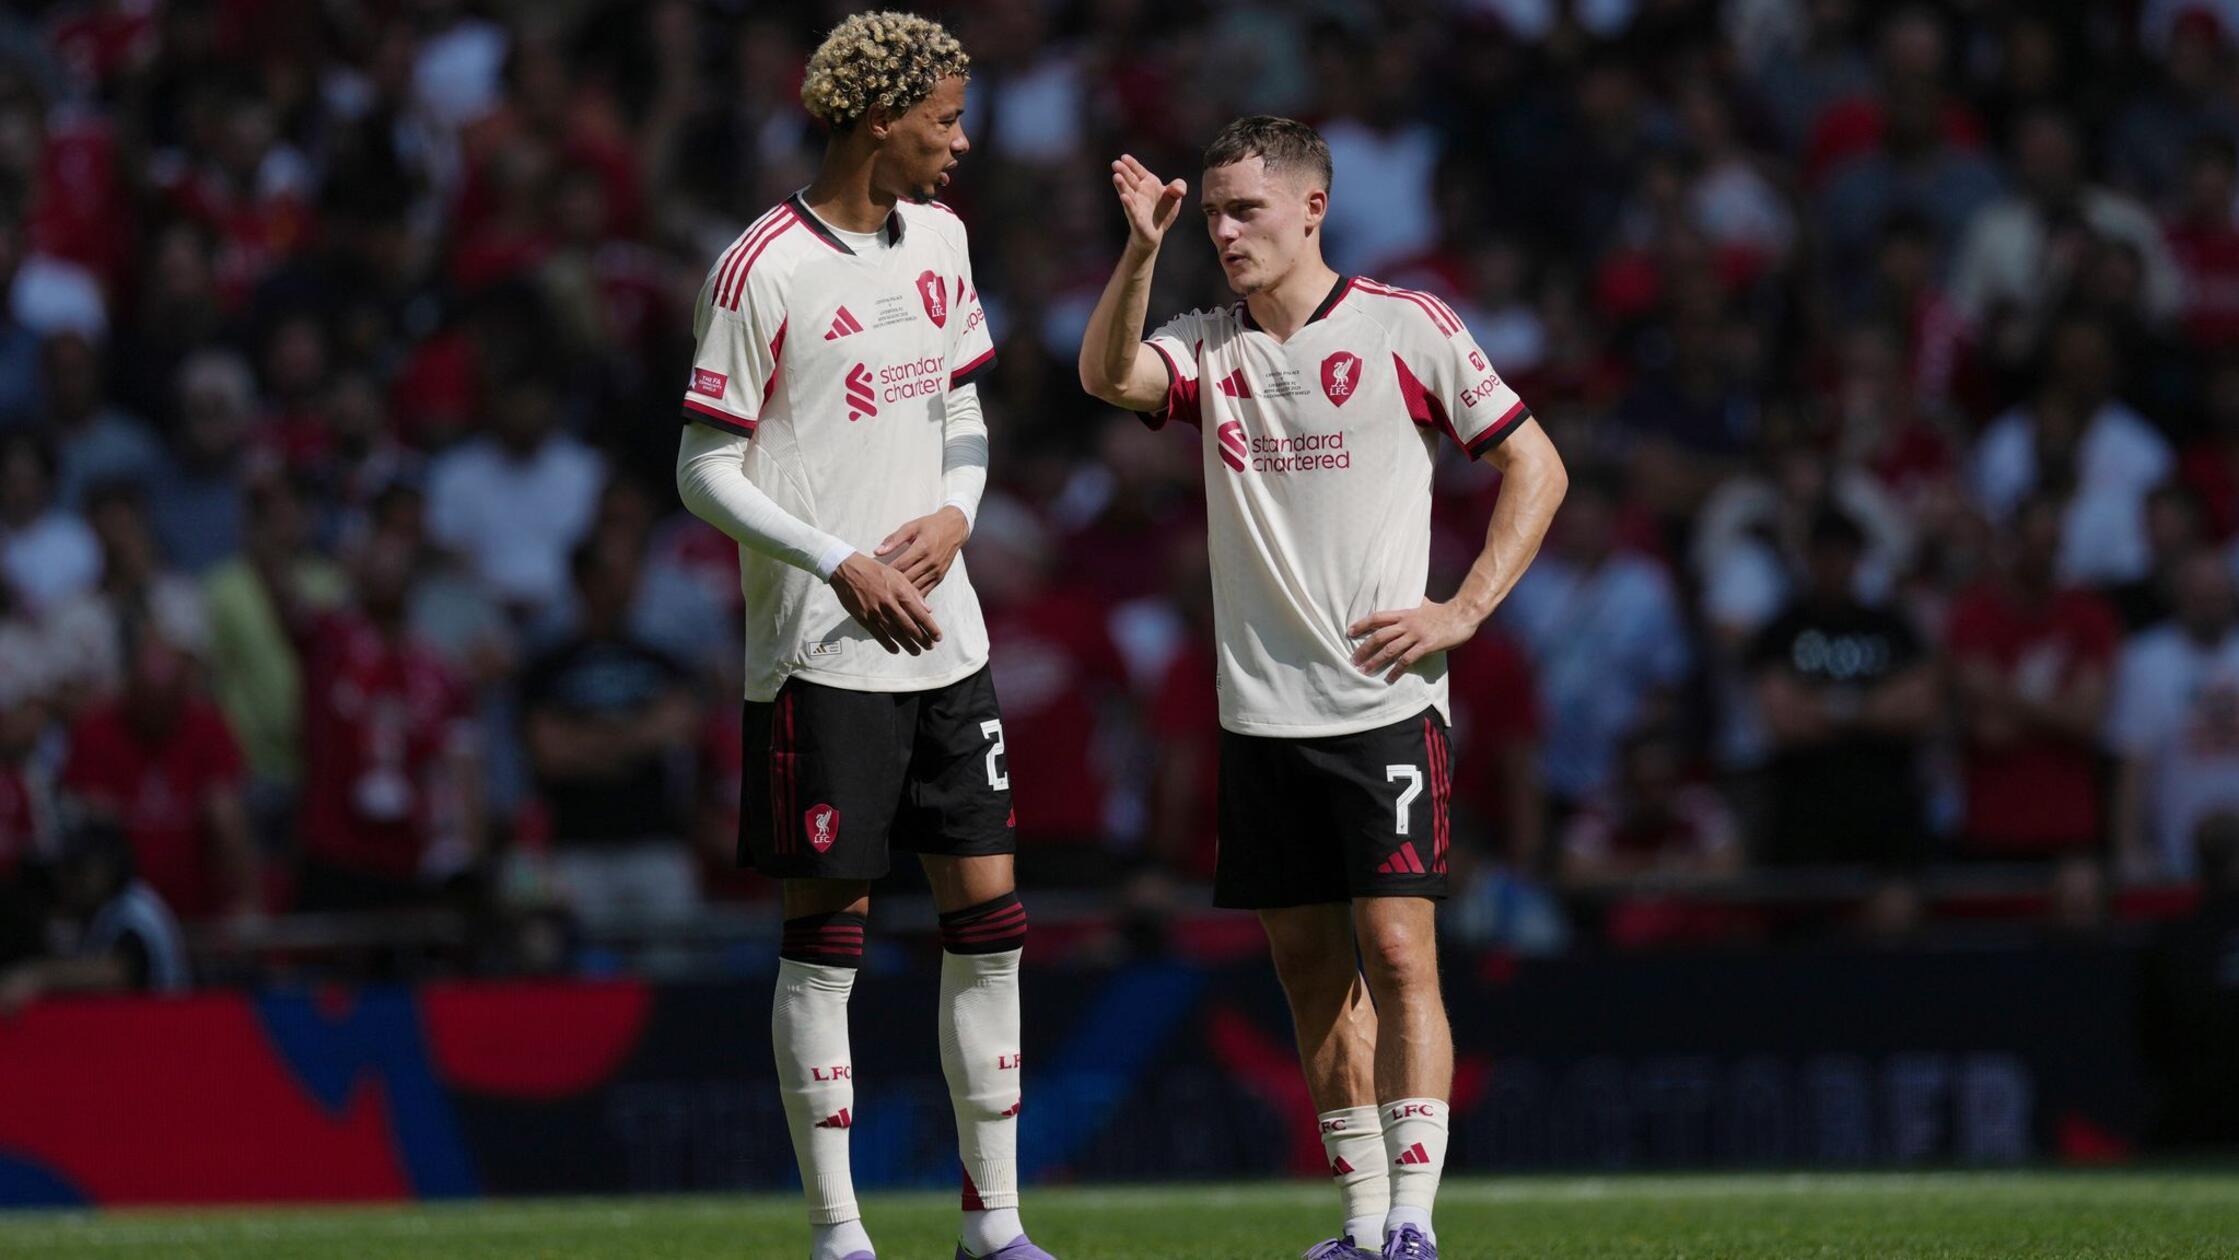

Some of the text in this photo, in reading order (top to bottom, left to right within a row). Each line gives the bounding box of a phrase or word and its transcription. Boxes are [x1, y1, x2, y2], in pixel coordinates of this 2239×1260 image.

[1329, 387, 1350, 396] LFC
[1460, 374, 1501, 408] Expe
[1252, 431, 1343, 453] standard
[1252, 450, 1350, 473] chartered
[979, 718, 1010, 792] 2
[1386, 764, 1423, 835] 7
[814, 834, 831, 843] LFC
[1392, 1104, 1434, 1121] LFC
